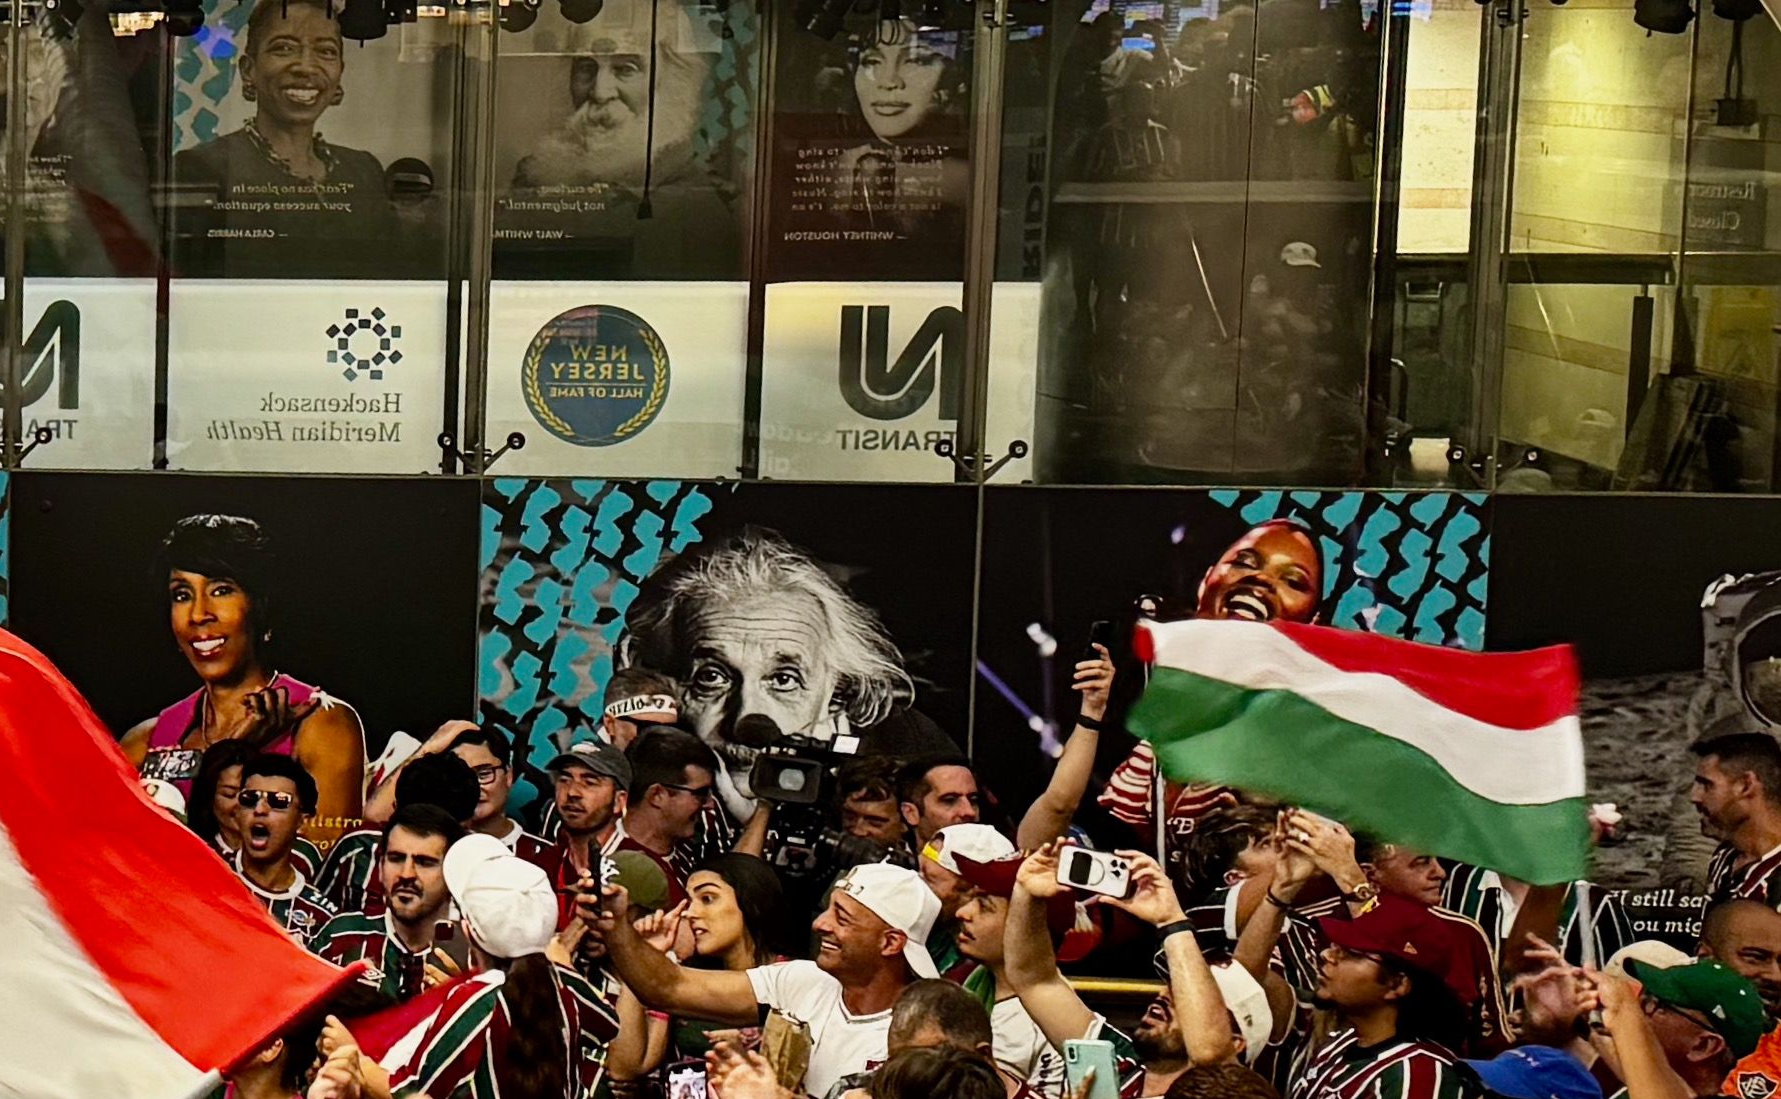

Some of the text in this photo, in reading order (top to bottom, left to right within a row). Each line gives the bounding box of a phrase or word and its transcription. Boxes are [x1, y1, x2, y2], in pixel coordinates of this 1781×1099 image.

[1631, 888, 1675, 907] still
[1678, 895, 1703, 908] sa
[1633, 920, 1659, 932] ou
